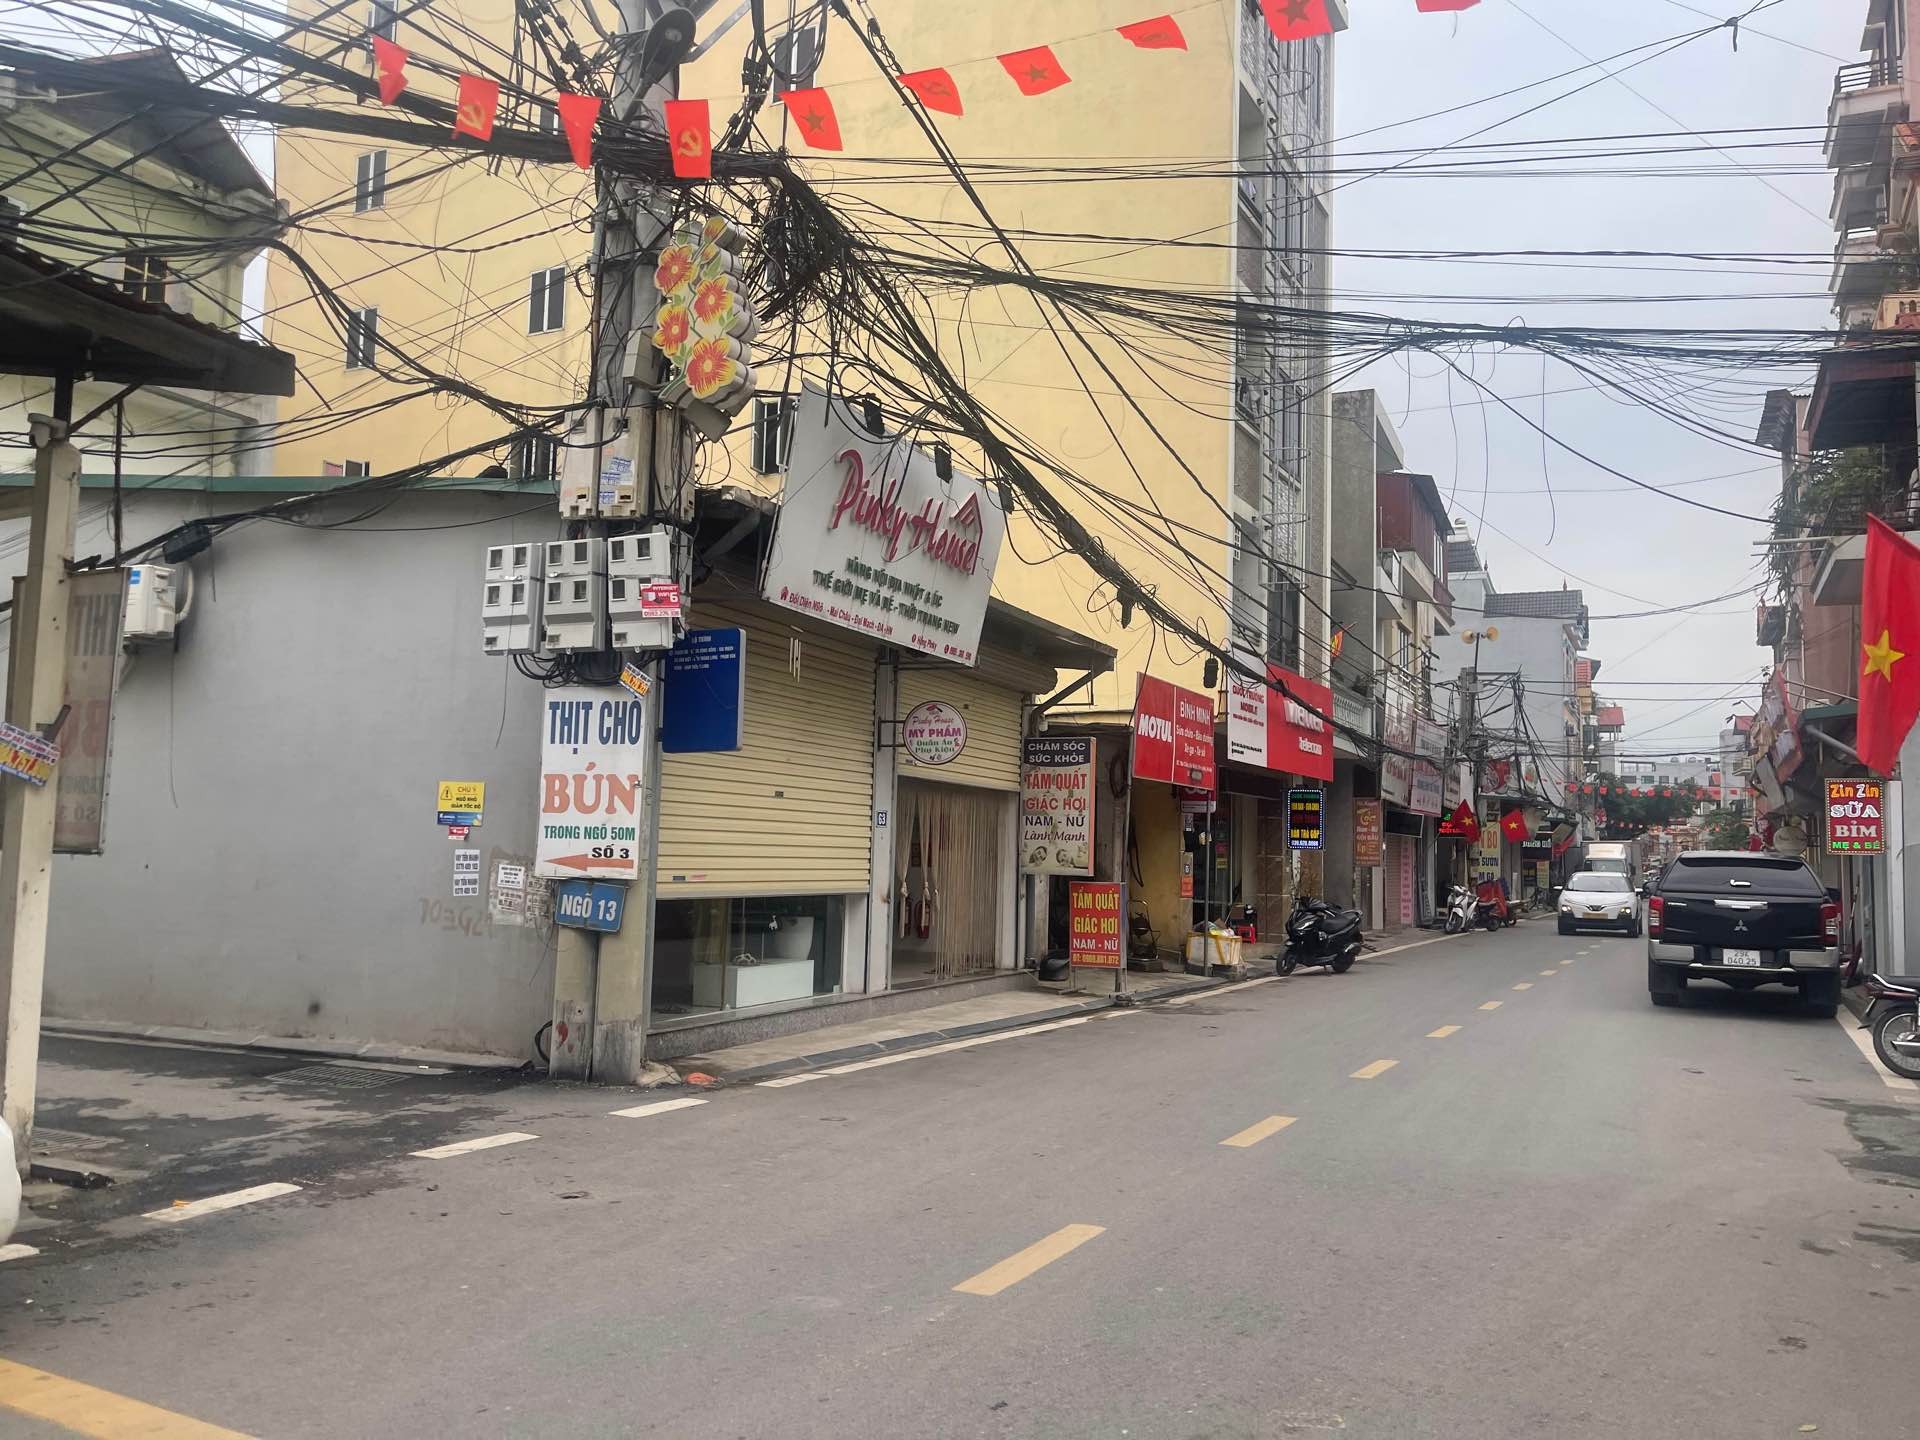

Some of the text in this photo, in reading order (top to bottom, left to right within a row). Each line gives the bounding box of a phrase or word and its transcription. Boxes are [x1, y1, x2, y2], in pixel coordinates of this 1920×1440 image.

[831, 449, 977, 571] Pinky House
[670, 592, 678, 602] 6
[917, 609, 943, 629] TRANG
[943, 619, 960, 635] NEW
[1180, 698, 1195, 720] BÌNH
[1196, 706, 1211, 726] MINH
[549, 701, 593, 755] THỊT
[1138, 713, 1173, 743] MOTUL
[1028, 741, 1086, 751] CHĂM SÓC
[1029, 752, 1085, 763] SỨC KHỎE
[542, 762, 638, 815] BÚN
[1830, 784, 1879, 798] Zin Zin
[1831, 801, 1880, 818] SỮA
[1025, 815, 1053, 826] NAM
[1835, 820, 1877, 837] BỈM
[544, 823, 635, 841] TRONG NGÕ 50M
[1024, 830, 1085, 843] Lành Mạnh
[592, 843, 629, 859] SỐ 3
[1832, 842, 1849, 850] MẸ
[560, 893, 592, 918] NGÕ
[598, 899, 617, 921] 13
[1073, 887, 1119, 911] TẨM QUẤT
[1074, 914, 1118, 934] GIÁC HƠI
[1073, 938, 1096, 949] NAM
[1104, 938, 1119, 950] NỮ
